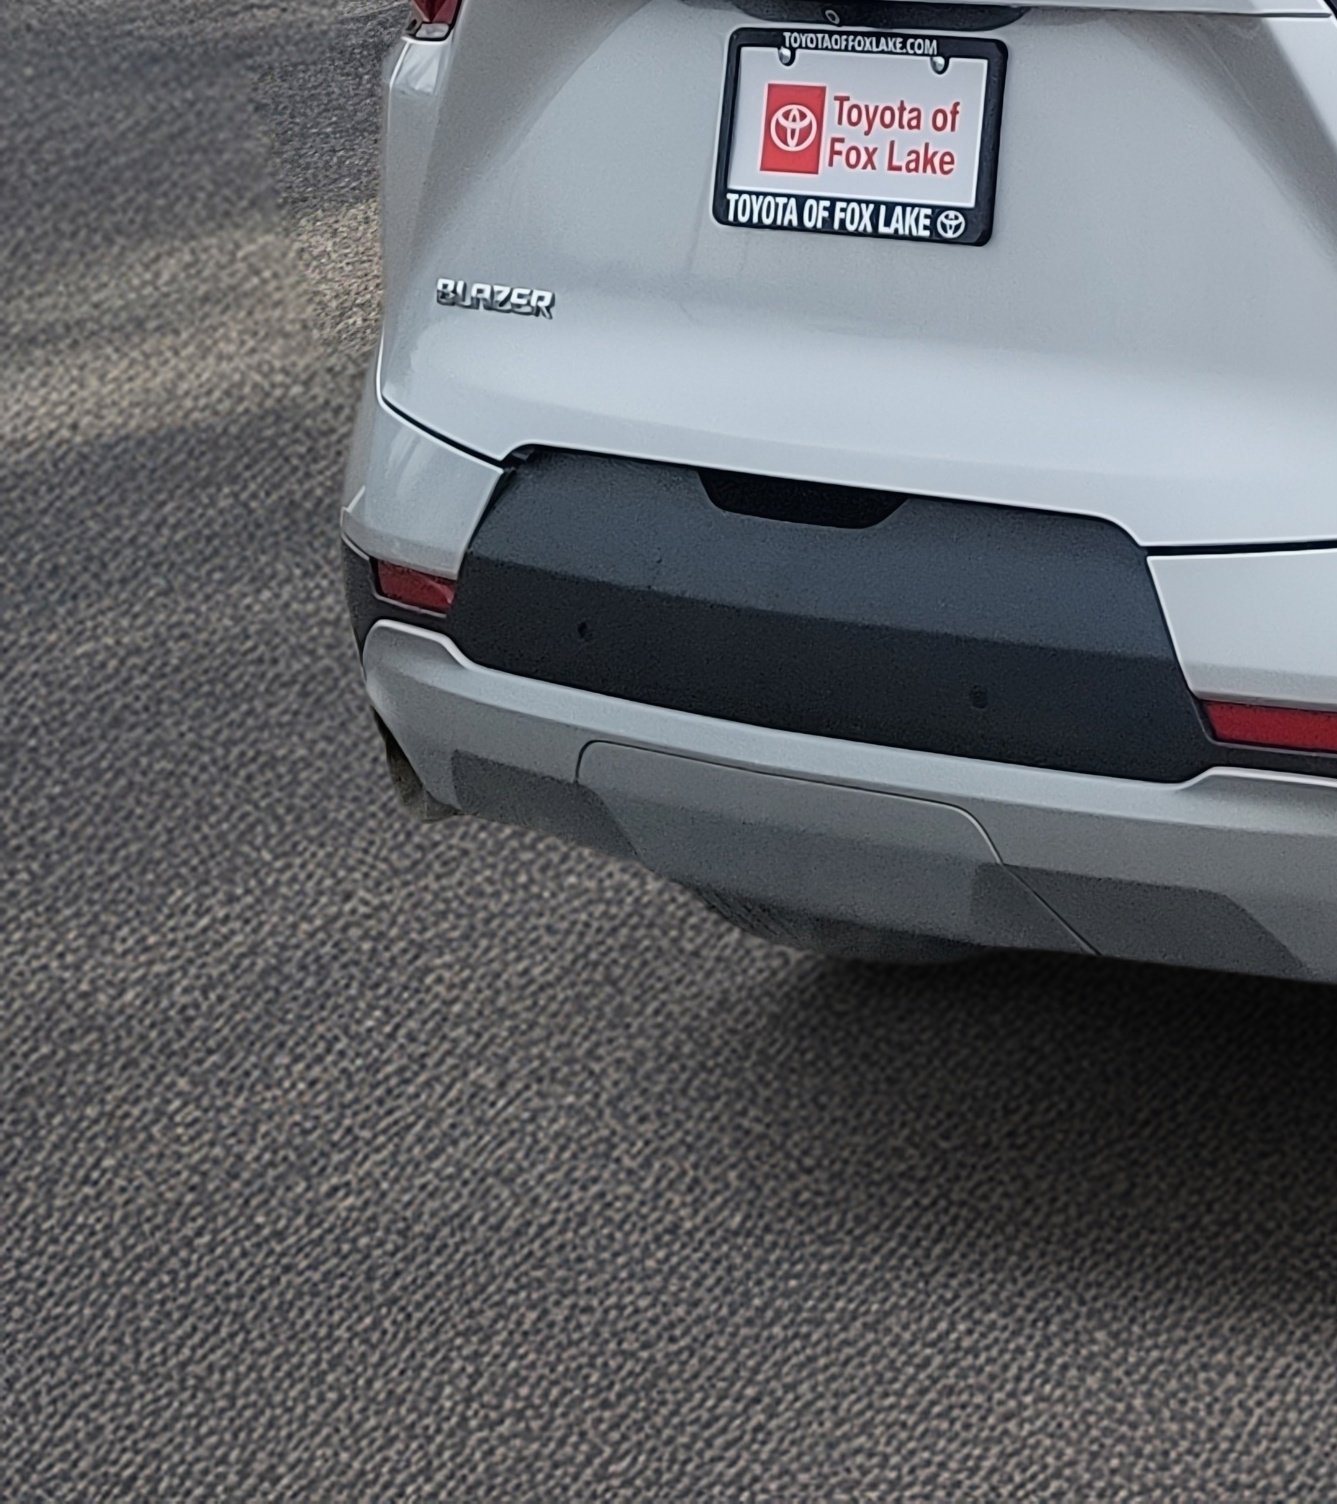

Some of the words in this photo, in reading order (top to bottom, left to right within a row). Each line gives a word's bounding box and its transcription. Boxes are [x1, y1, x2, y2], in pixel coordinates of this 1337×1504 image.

[783, 31, 938, 56] TOYOTAOFFOXLAKE.COM
[833, 95, 922, 136] Toyota
[931, 101, 961, 133] of
[827, 137, 878, 171] Fox
[887, 140, 955, 176] Lake
[726, 193, 798, 227] TOYOTA
[803, 199, 830, 229] OF
[833, 202, 875, 233] FOX
[878, 205, 931, 237] LAKE
[436, 278, 555, 320] BLAZER
